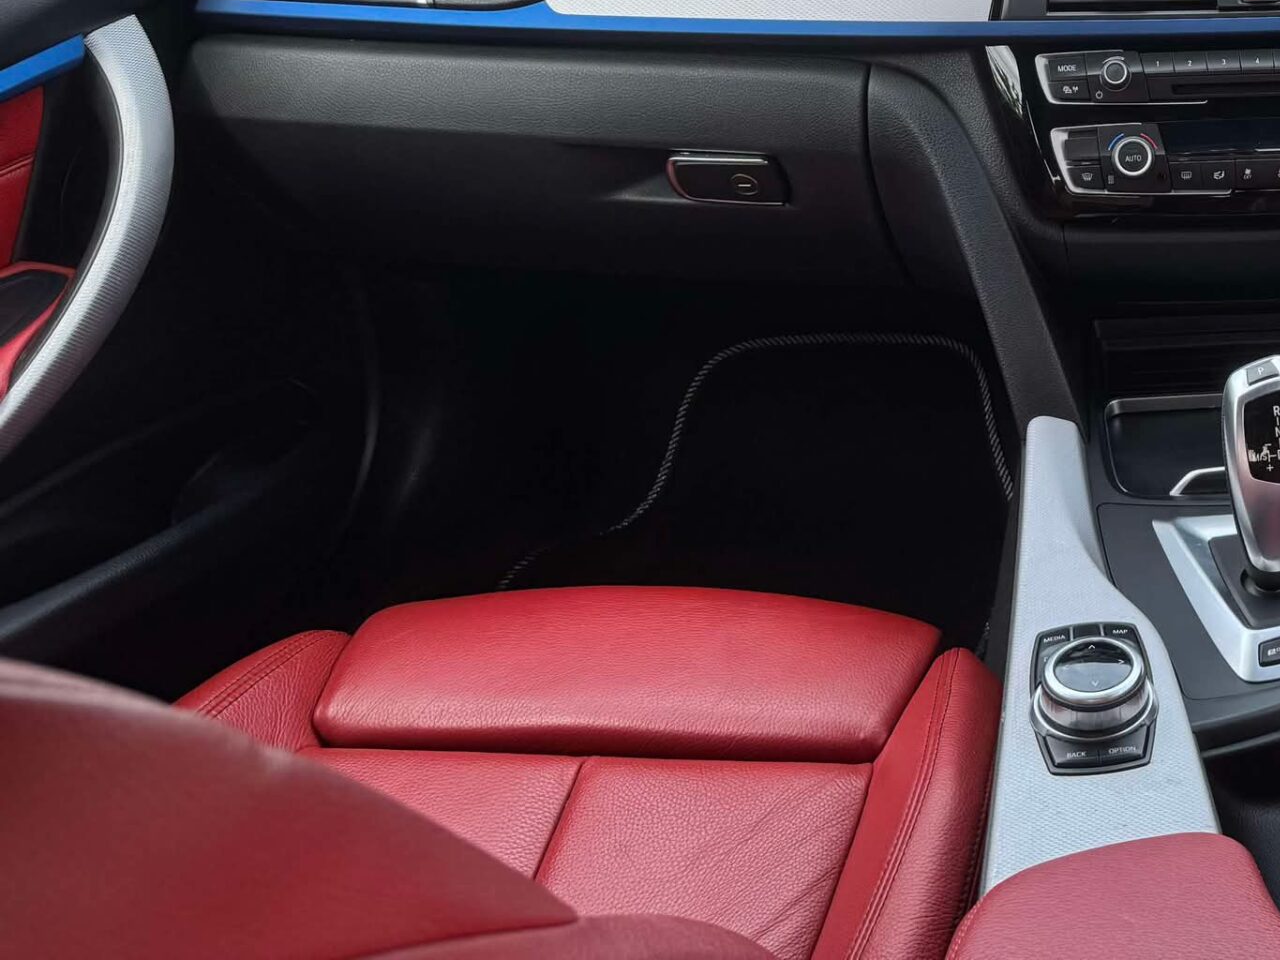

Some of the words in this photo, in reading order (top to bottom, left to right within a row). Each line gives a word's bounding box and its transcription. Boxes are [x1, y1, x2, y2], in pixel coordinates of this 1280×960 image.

[1058, 64, 1077, 72] MODE
[1258, 367, 1264, 375] P
[1273, 405, 1280, 416] R
[1044, 635, 1066, 643] MEDIA
[1108, 746, 1137, 754] OPTION
[1067, 751, 1087, 759] BACK
